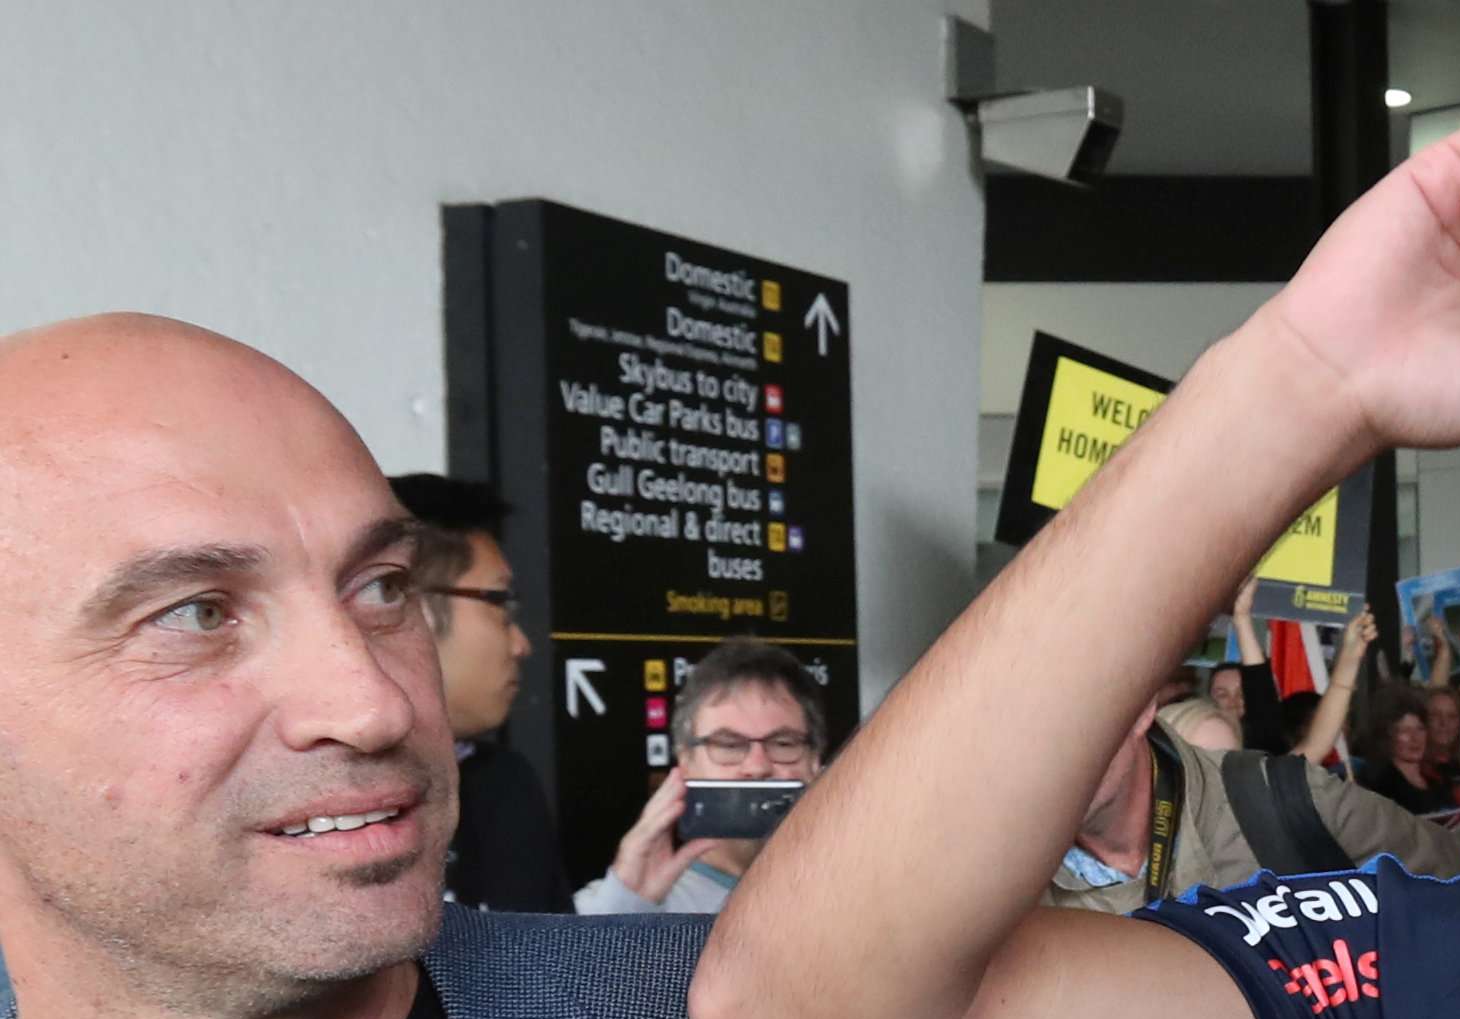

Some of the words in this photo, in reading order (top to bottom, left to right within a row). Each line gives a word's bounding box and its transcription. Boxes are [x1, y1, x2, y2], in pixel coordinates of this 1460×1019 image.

[665, 251, 755, 300] Domestic
[666, 307, 756, 353] Domestic
[619, 352, 692, 394] Skybus
[698, 374, 720, 398] to
[723, 374, 758, 412] city
[561, 379, 624, 418] Value
[628, 393, 665, 425] Car
[669, 400, 722, 434] Parks
[726, 408, 759, 440] bus
[601, 426, 666, 463] Public
[669, 438, 759, 476] transport
[587, 463, 633, 496] Gull
[638, 469, 723, 511] Geelong
[727, 480, 761, 510] bus
[581, 501, 678, 541] Regional
[684, 511, 699, 540] &
[705, 511, 761, 546] direct
[708, 549, 763, 581] buses
[666, 590, 729, 620] Smoking
[733, 597, 763, 616] area
